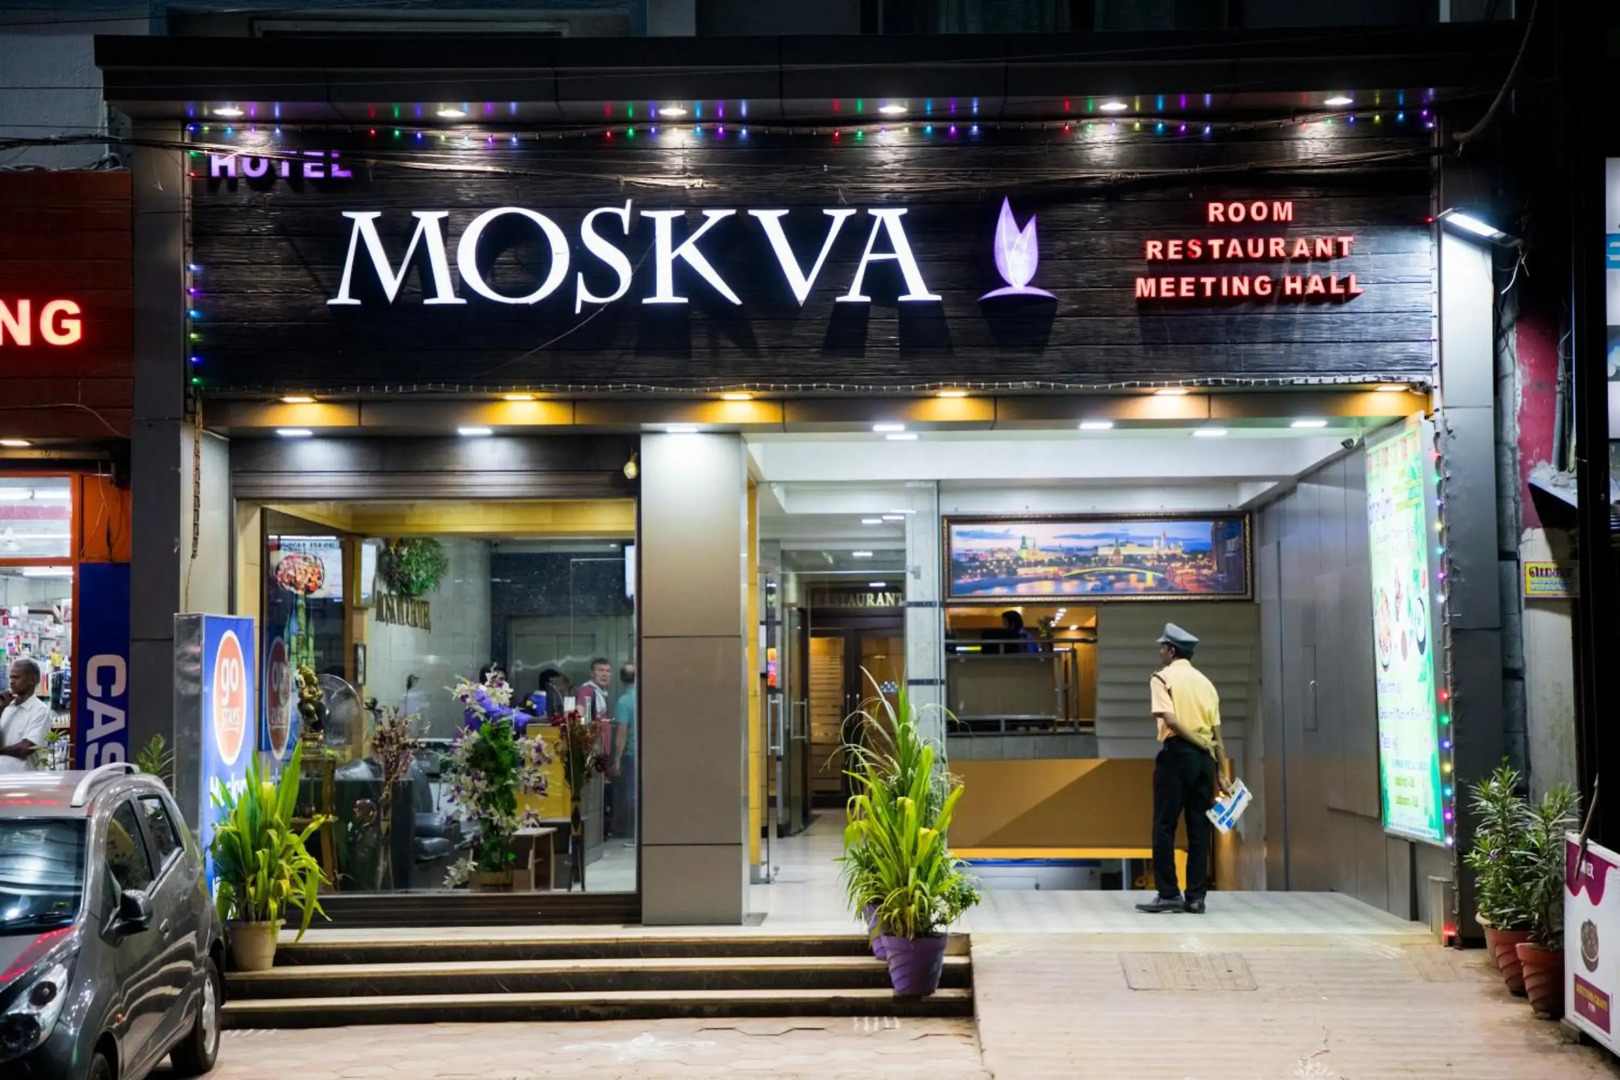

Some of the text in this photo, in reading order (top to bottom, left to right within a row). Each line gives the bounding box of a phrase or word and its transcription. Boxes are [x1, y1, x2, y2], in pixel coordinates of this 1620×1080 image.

[210, 150, 352, 177] HOTEL
[1207, 201, 1294, 223] ROOM
[327, 199, 943, 314] MOSKVA
[1145, 236, 1354, 260] RESTAURANT
[1135, 272, 1364, 298] MEETING HALL
[0, 299, 82, 346] NG
[221, 657, 240, 706] go
